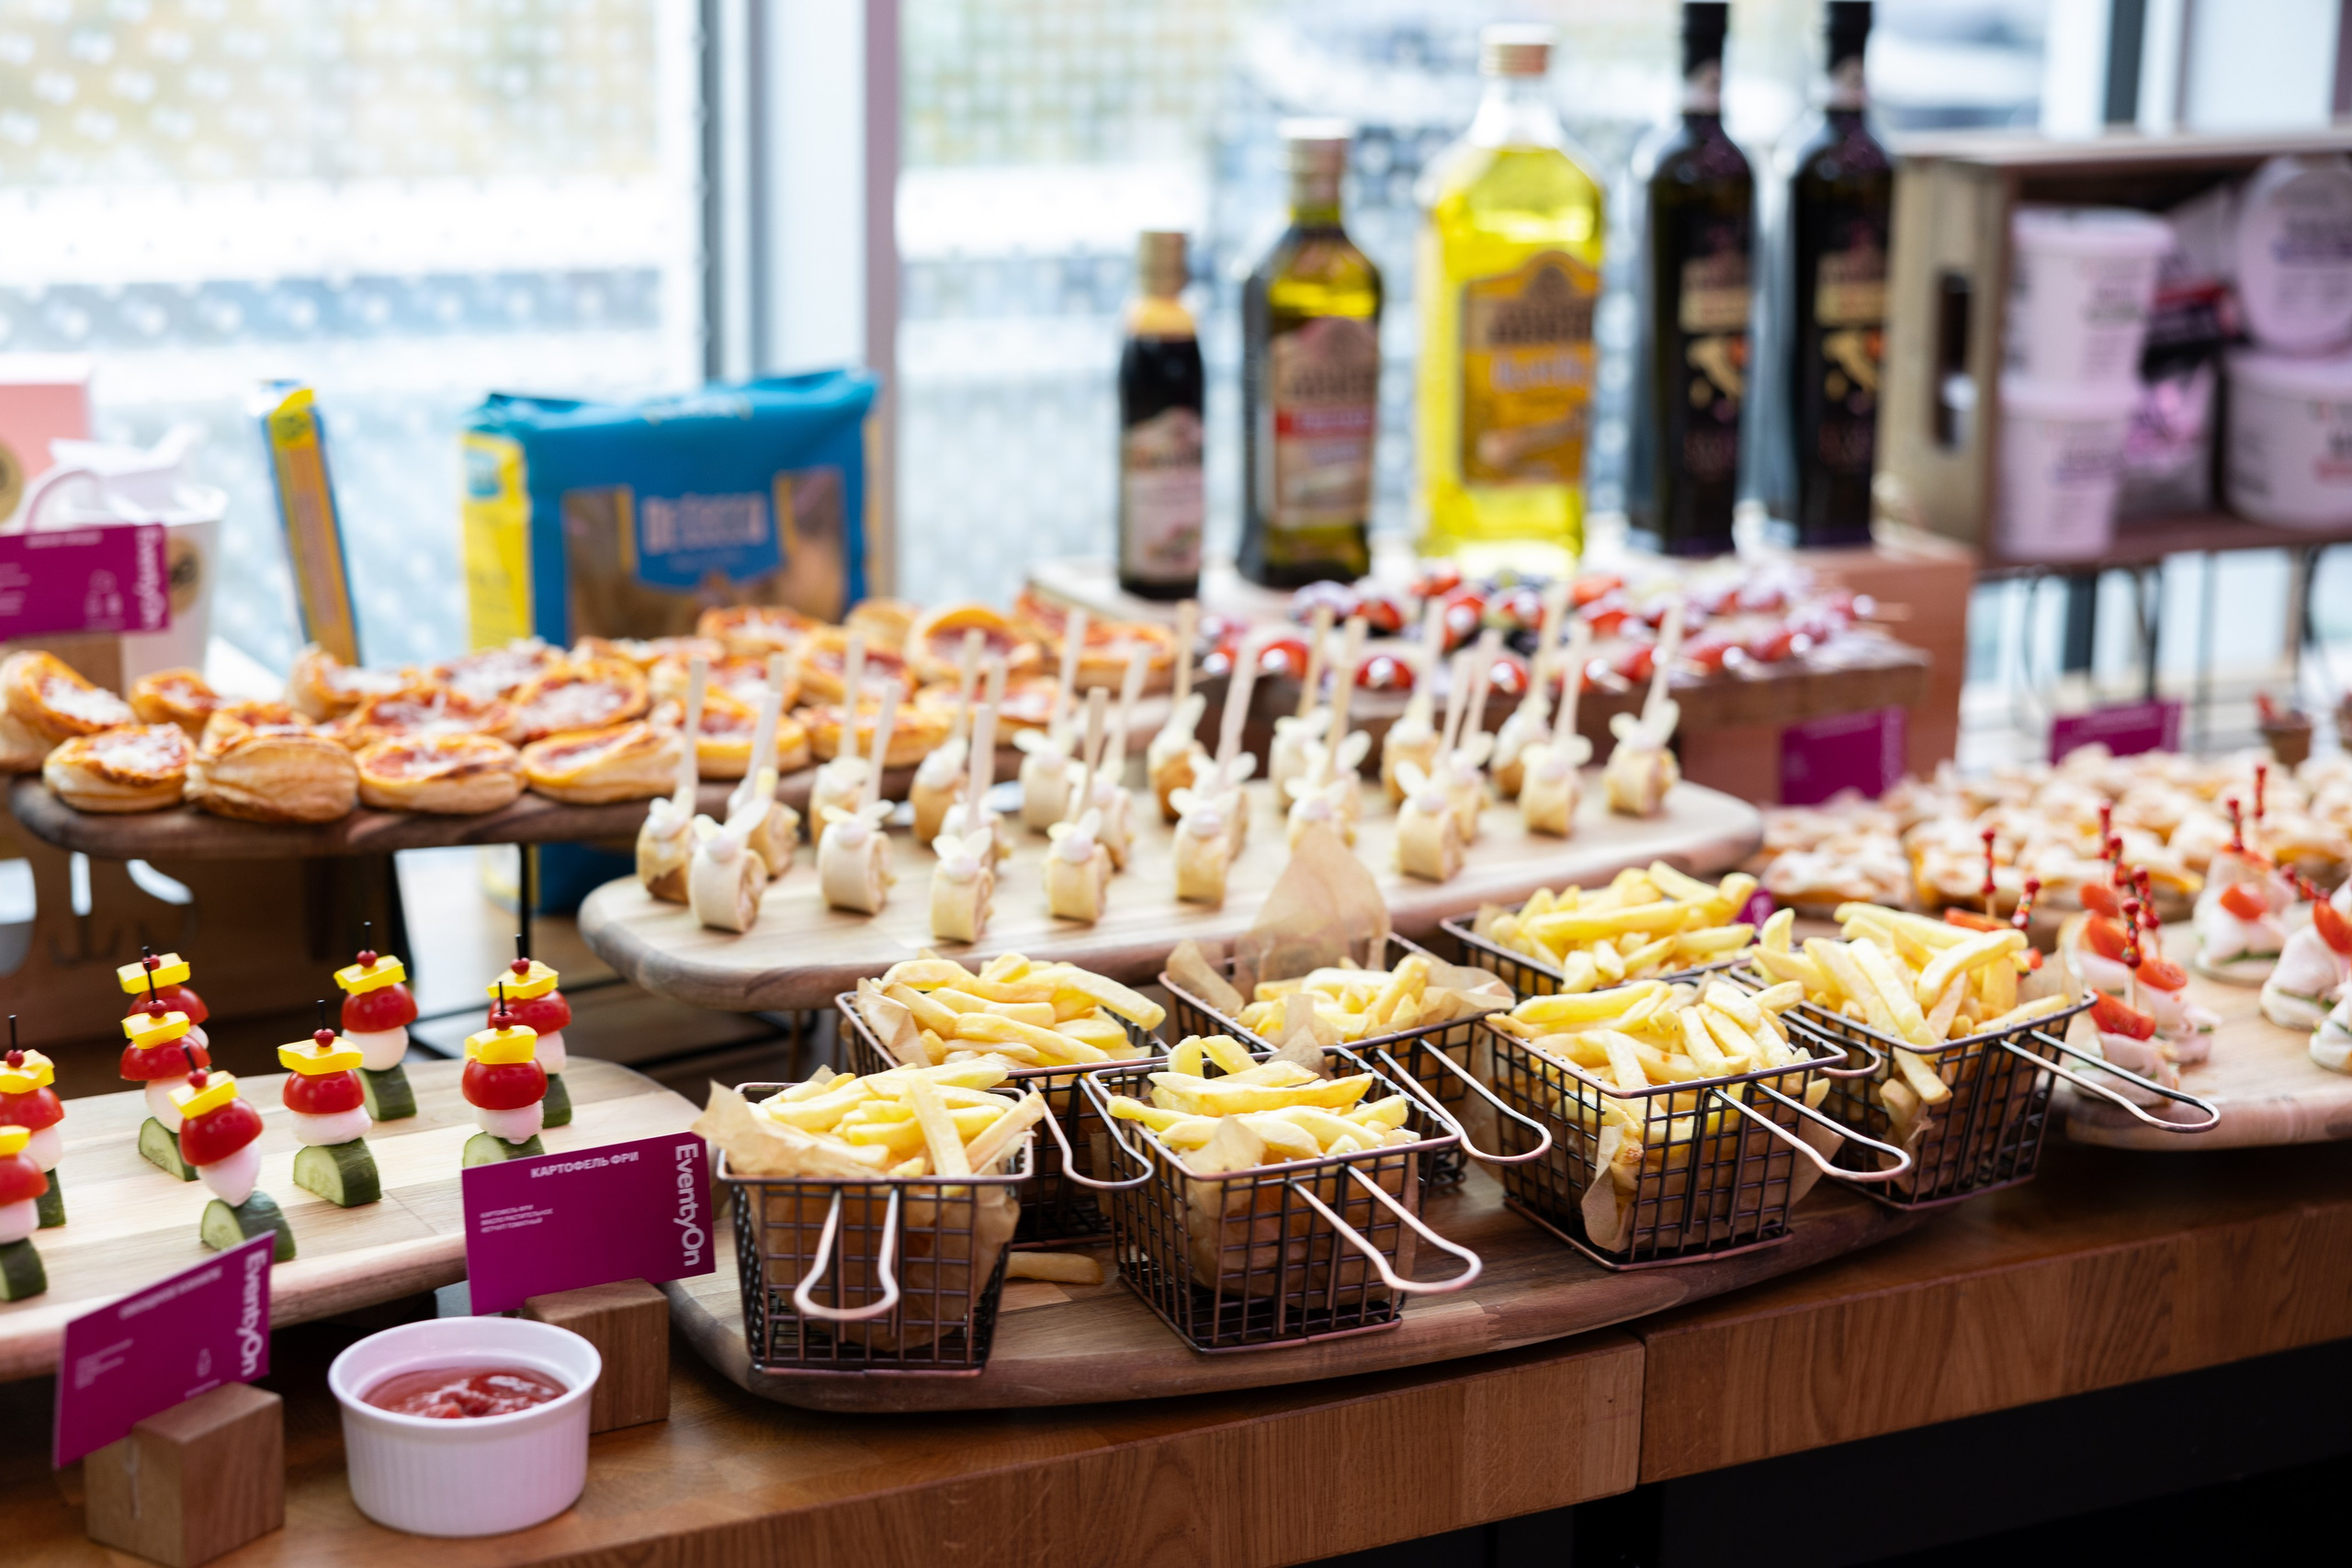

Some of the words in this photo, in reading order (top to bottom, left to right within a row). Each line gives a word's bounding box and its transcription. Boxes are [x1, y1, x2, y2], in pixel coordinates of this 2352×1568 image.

[530, 1157, 609, 1179] КАРТОФЕЛЬ
[610, 1151, 639, 1164] ФРИ
[673, 1143, 705, 1267] EventyOn
[236, 1248, 267, 1376] EventyOn
